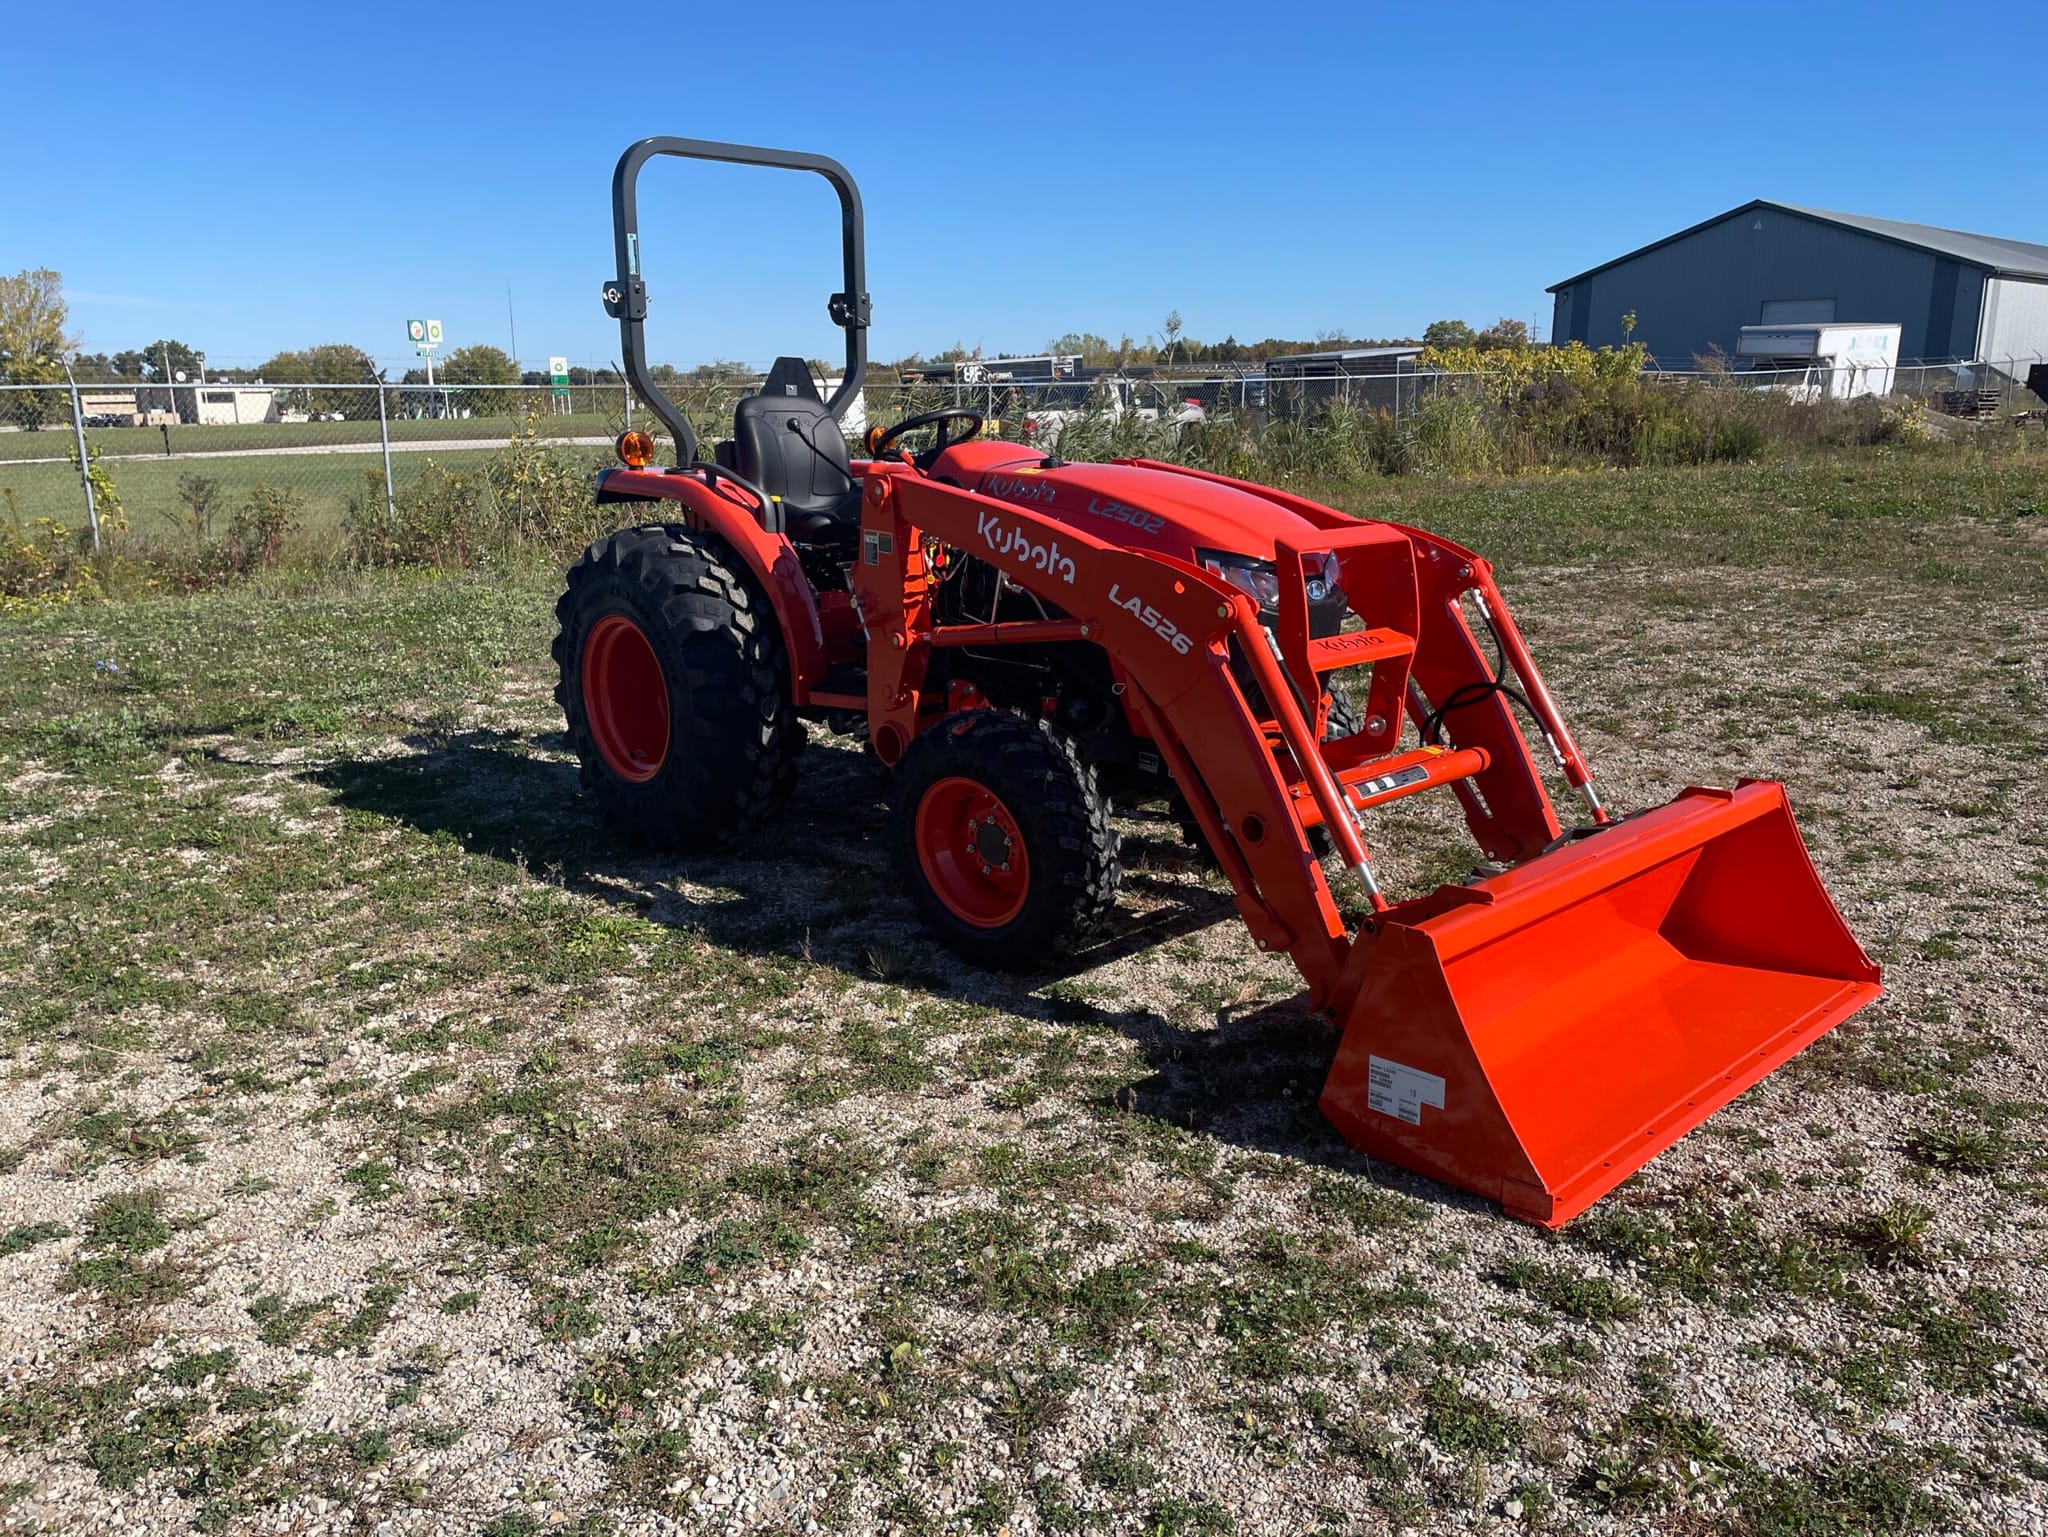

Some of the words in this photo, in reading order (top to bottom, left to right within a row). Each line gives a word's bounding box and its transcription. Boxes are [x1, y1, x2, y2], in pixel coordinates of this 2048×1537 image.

[986, 474, 1056, 503] Kubota
[1087, 497, 1166, 535] L2502
[976, 511, 1076, 585] Kubota
[1108, 583, 1195, 655] LA526
[1316, 634, 1385, 651] Kubota
